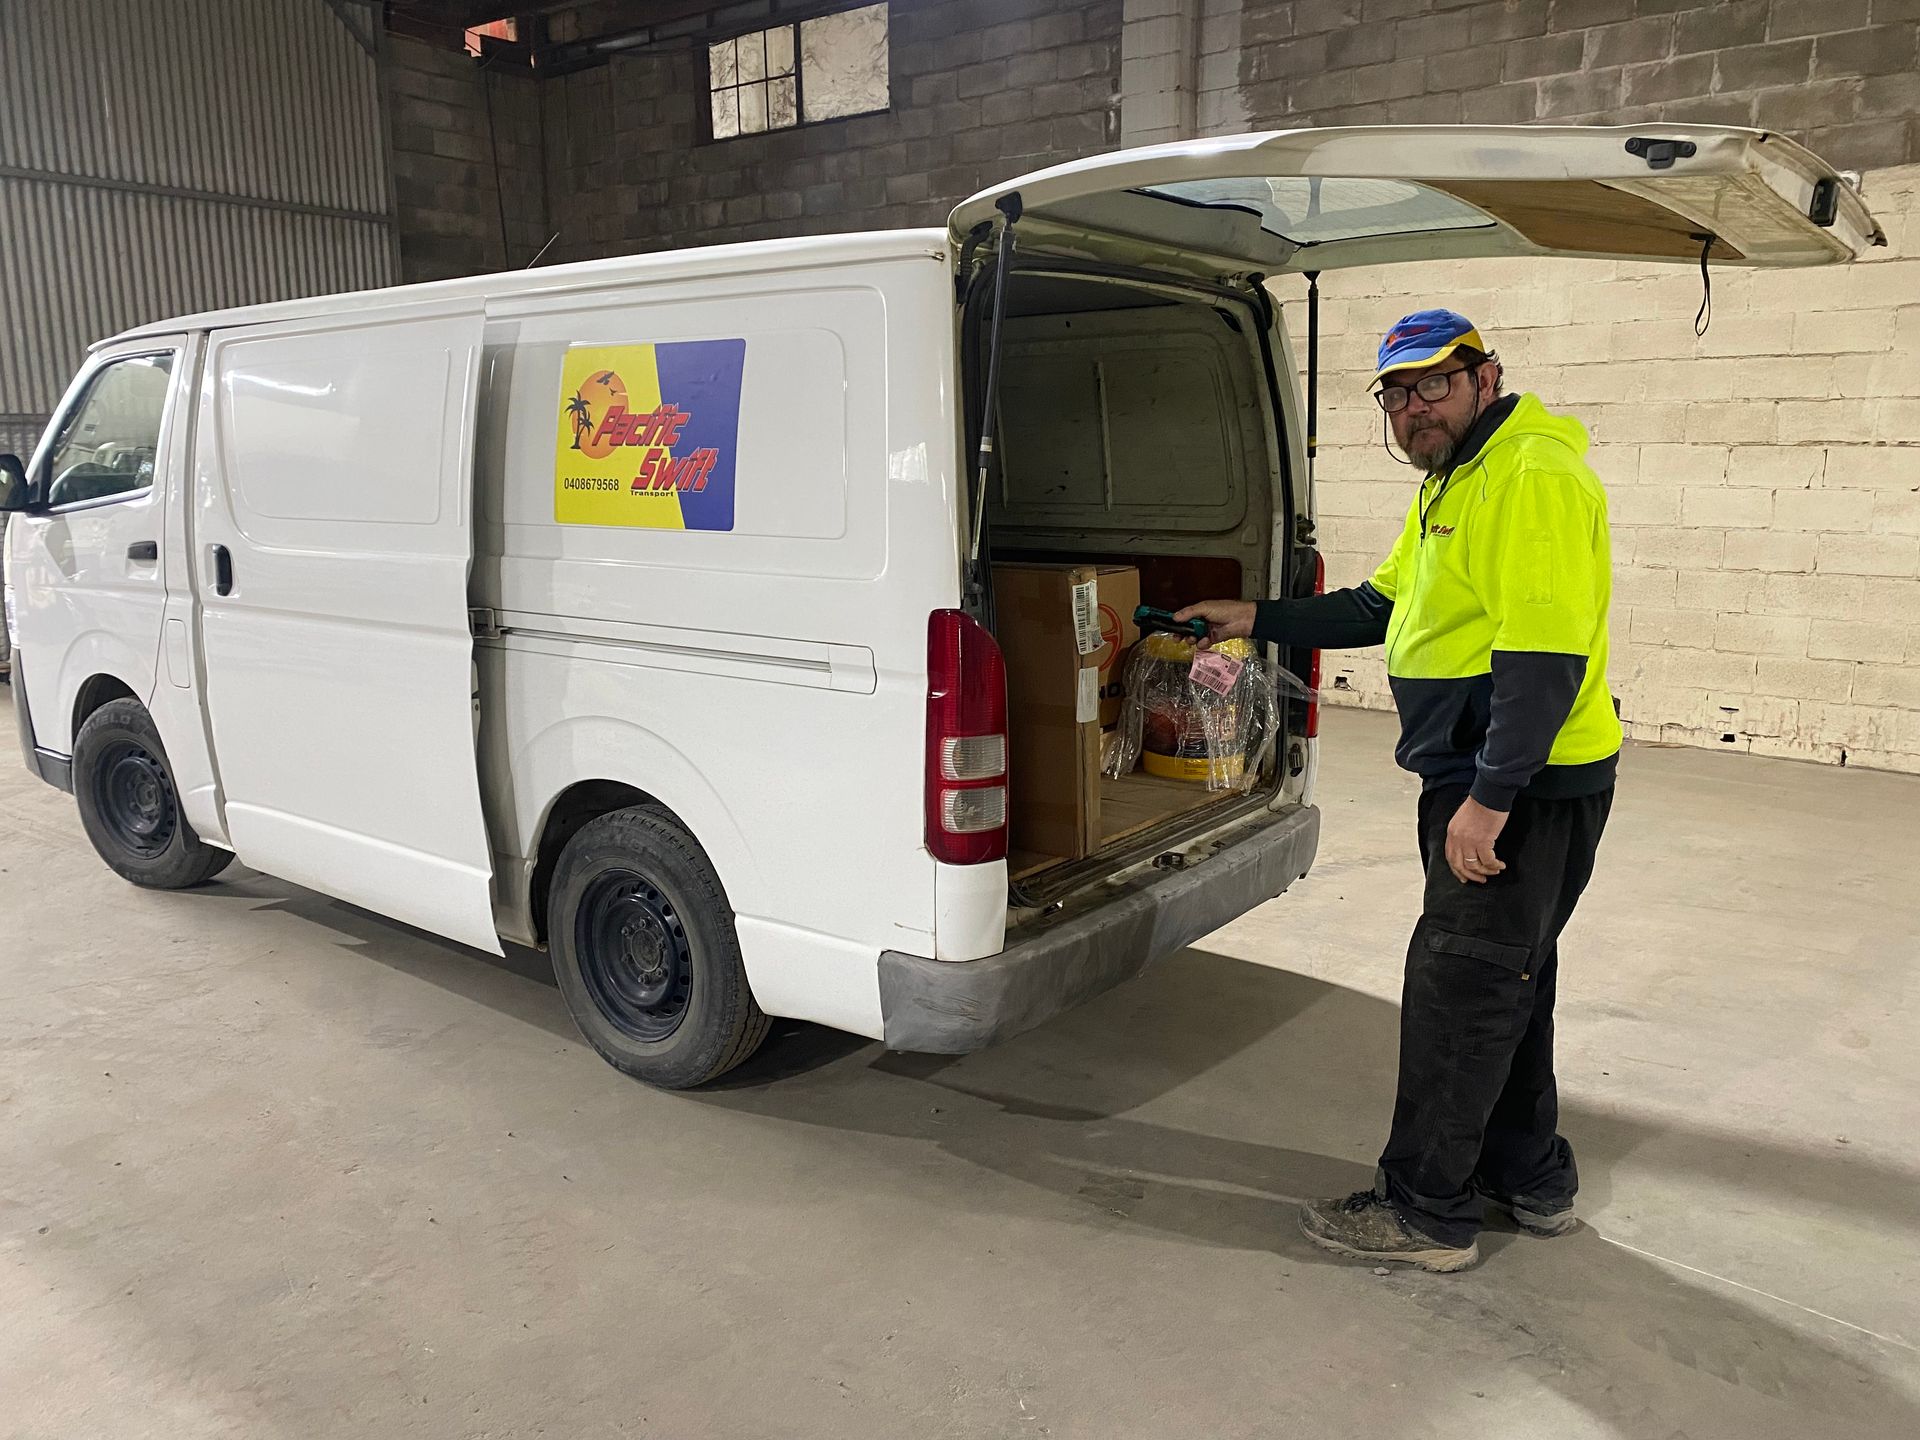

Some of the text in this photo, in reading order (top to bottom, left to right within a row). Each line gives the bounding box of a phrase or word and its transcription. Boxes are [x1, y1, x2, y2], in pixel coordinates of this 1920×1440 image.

[592, 403, 691, 447] Pacific
[564, 478, 619, 491] 0408679568
[631, 447, 719, 492] Swift
